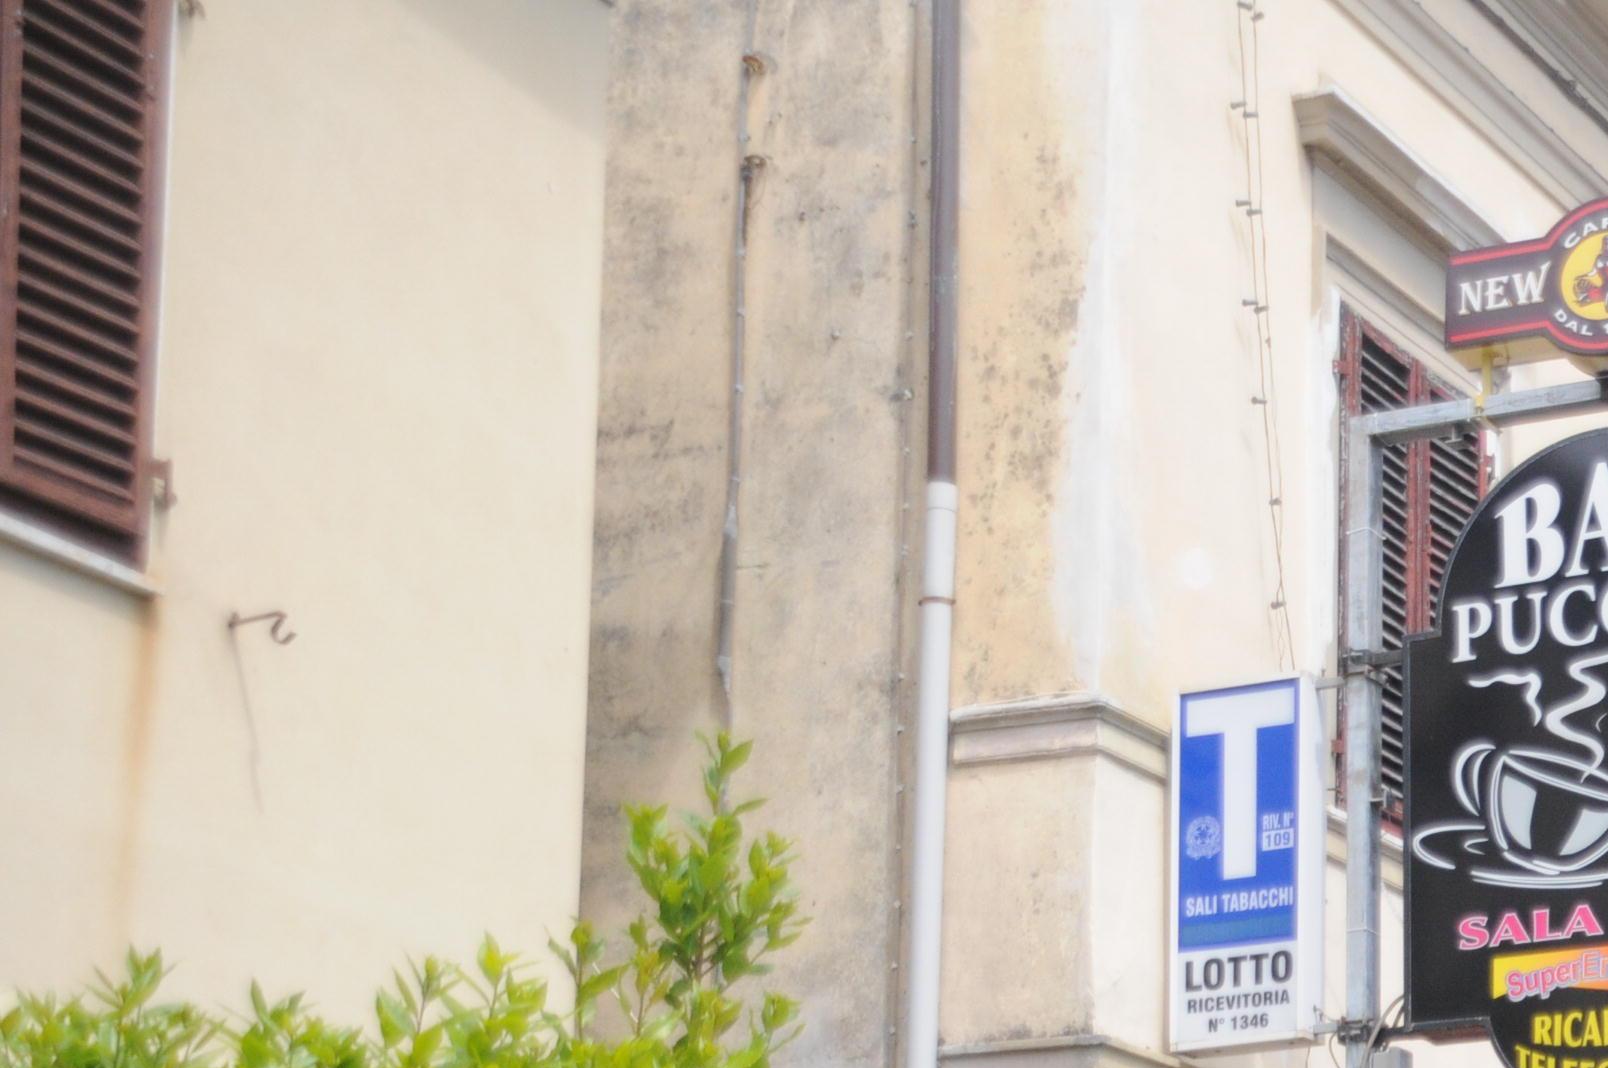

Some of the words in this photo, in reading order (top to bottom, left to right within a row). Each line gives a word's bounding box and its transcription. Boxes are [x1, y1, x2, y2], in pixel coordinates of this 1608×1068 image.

[1458, 261, 1550, 316] NEW
[1553, 309, 1593, 336] DAL
[1186, 687, 1295, 880] T
[1265, 831, 1290, 848] 109
[1186, 895, 1218, 918] SALI
[1222, 886, 1294, 913] TABACCHI
[1458, 904, 1603, 950] SALA
[1185, 950, 1294, 992] LOTTO
[1187, 989, 1291, 1014] RICEVITORIA
[1230, 1013, 1269, 1030] 1346
